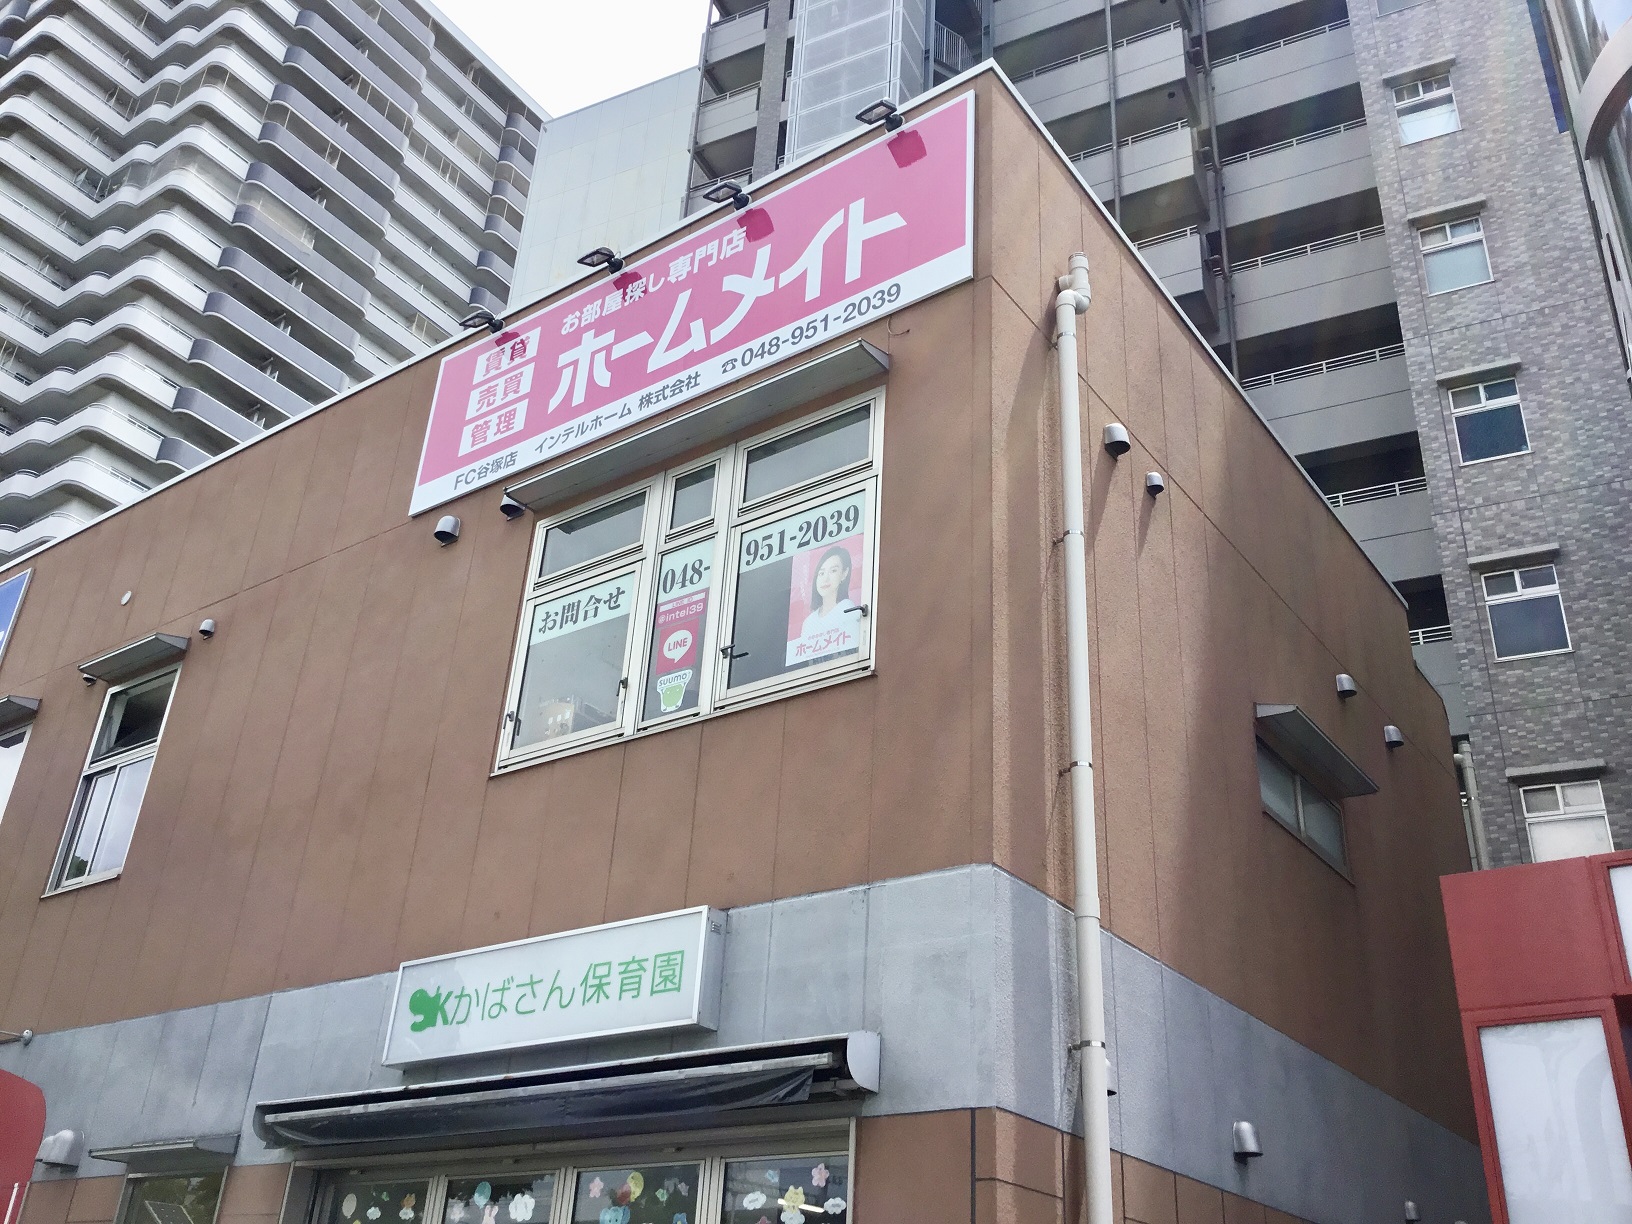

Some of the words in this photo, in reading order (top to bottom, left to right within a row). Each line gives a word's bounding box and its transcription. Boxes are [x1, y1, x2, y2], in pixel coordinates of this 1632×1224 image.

[561, 226, 747, 335] お部屋探し専門店
[548, 197, 907, 414] ホームメイト
[483, 336, 531, 377] 賃貸
[475, 370, 524, 413] 売買
[453, 450, 519, 491] FC谷塚店
[534, 402, 632, 454] インテルホーム
[637, 370, 702, 412] 株式会社
[470, 406, 518, 449] 管理
[537, 585, 627, 635] お問合せ
[661, 558, 711, 595] 048-
[744, 503, 861, 567] 951-2039
[658, 602, 704, 624] @intel39
[667, 637, 689, 652] LINE
[795, 630, 852, 657] ホームメイト
